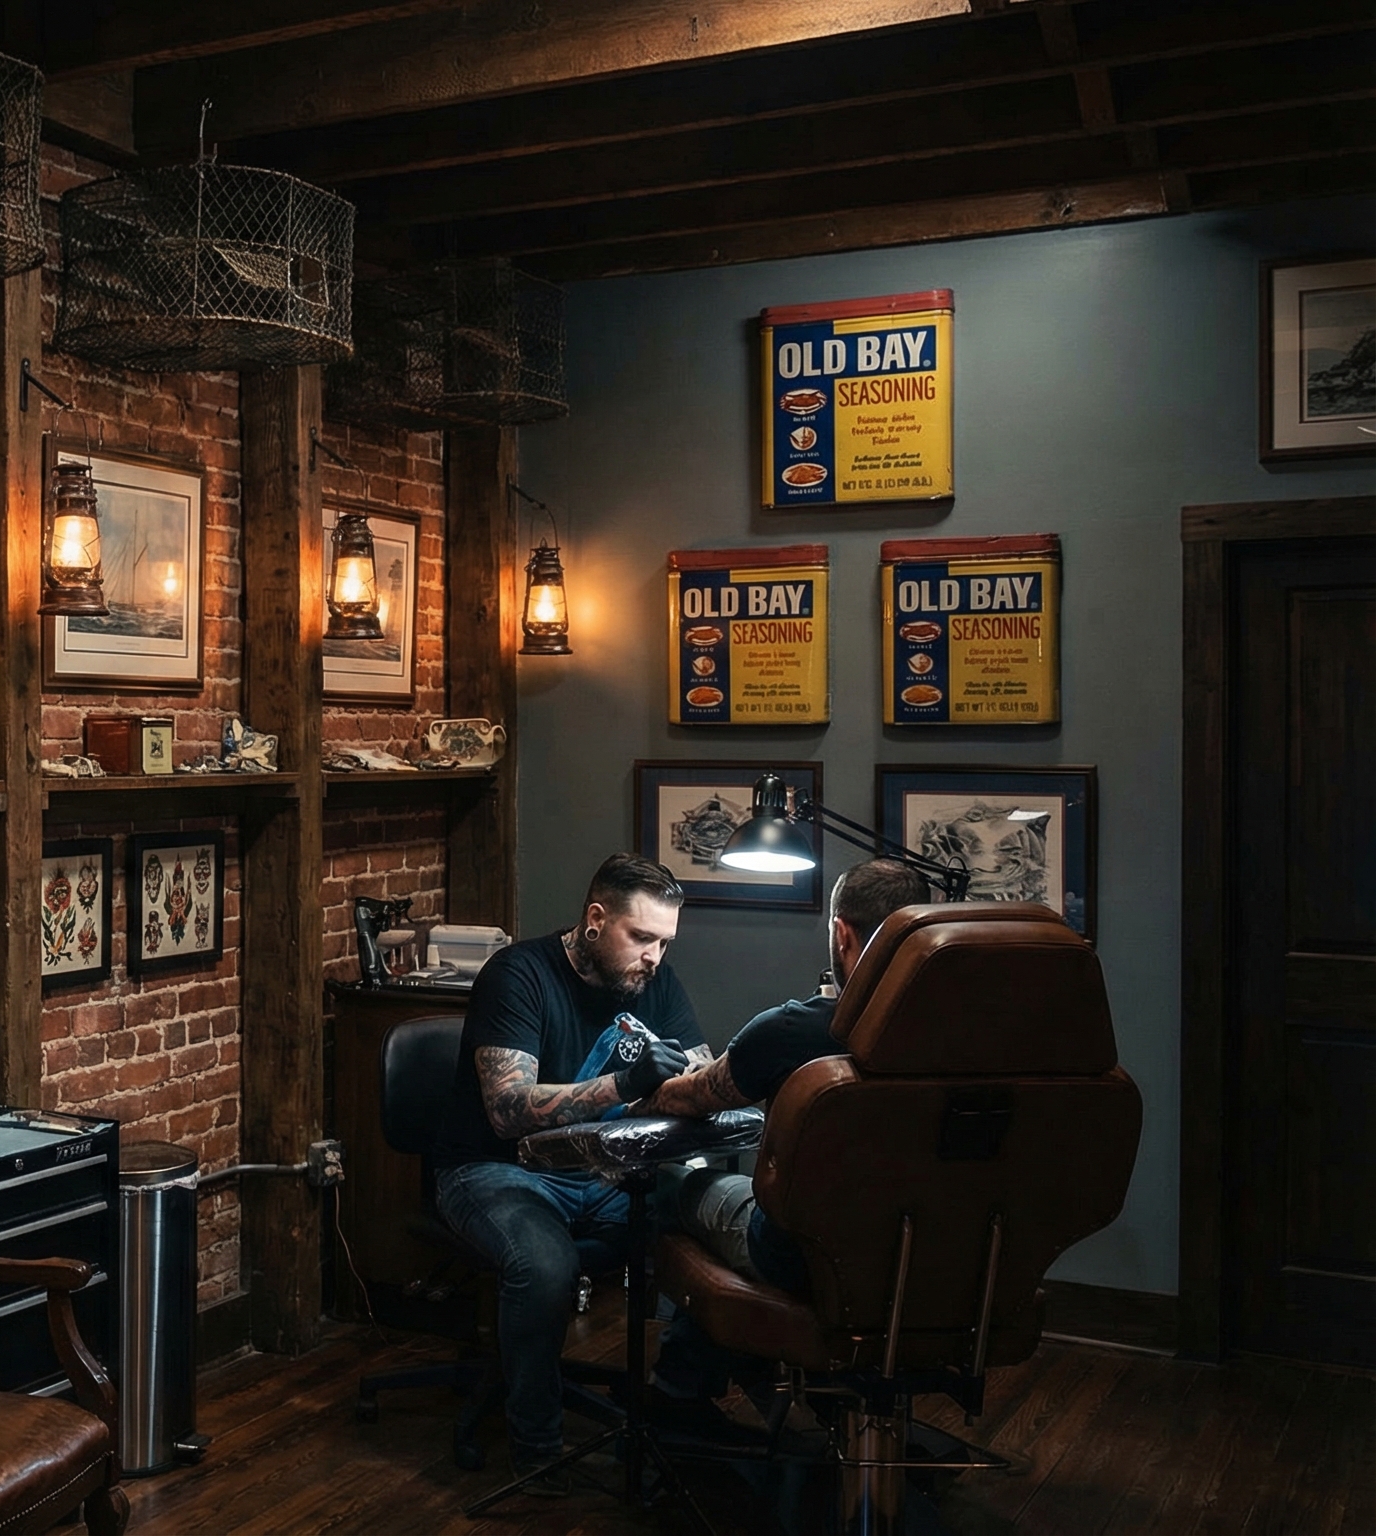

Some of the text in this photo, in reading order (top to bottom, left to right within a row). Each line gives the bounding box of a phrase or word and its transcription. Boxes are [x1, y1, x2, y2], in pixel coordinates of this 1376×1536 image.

[779, 339, 846, 379] OLD
[839, 376, 935, 407] SEASONING
[684, 585, 805, 618] OLD BAY
[899, 577, 1034, 612] OLD BAY
[733, 621, 812, 645] SEASONING
[952, 616, 1040, 640] SEASONING
